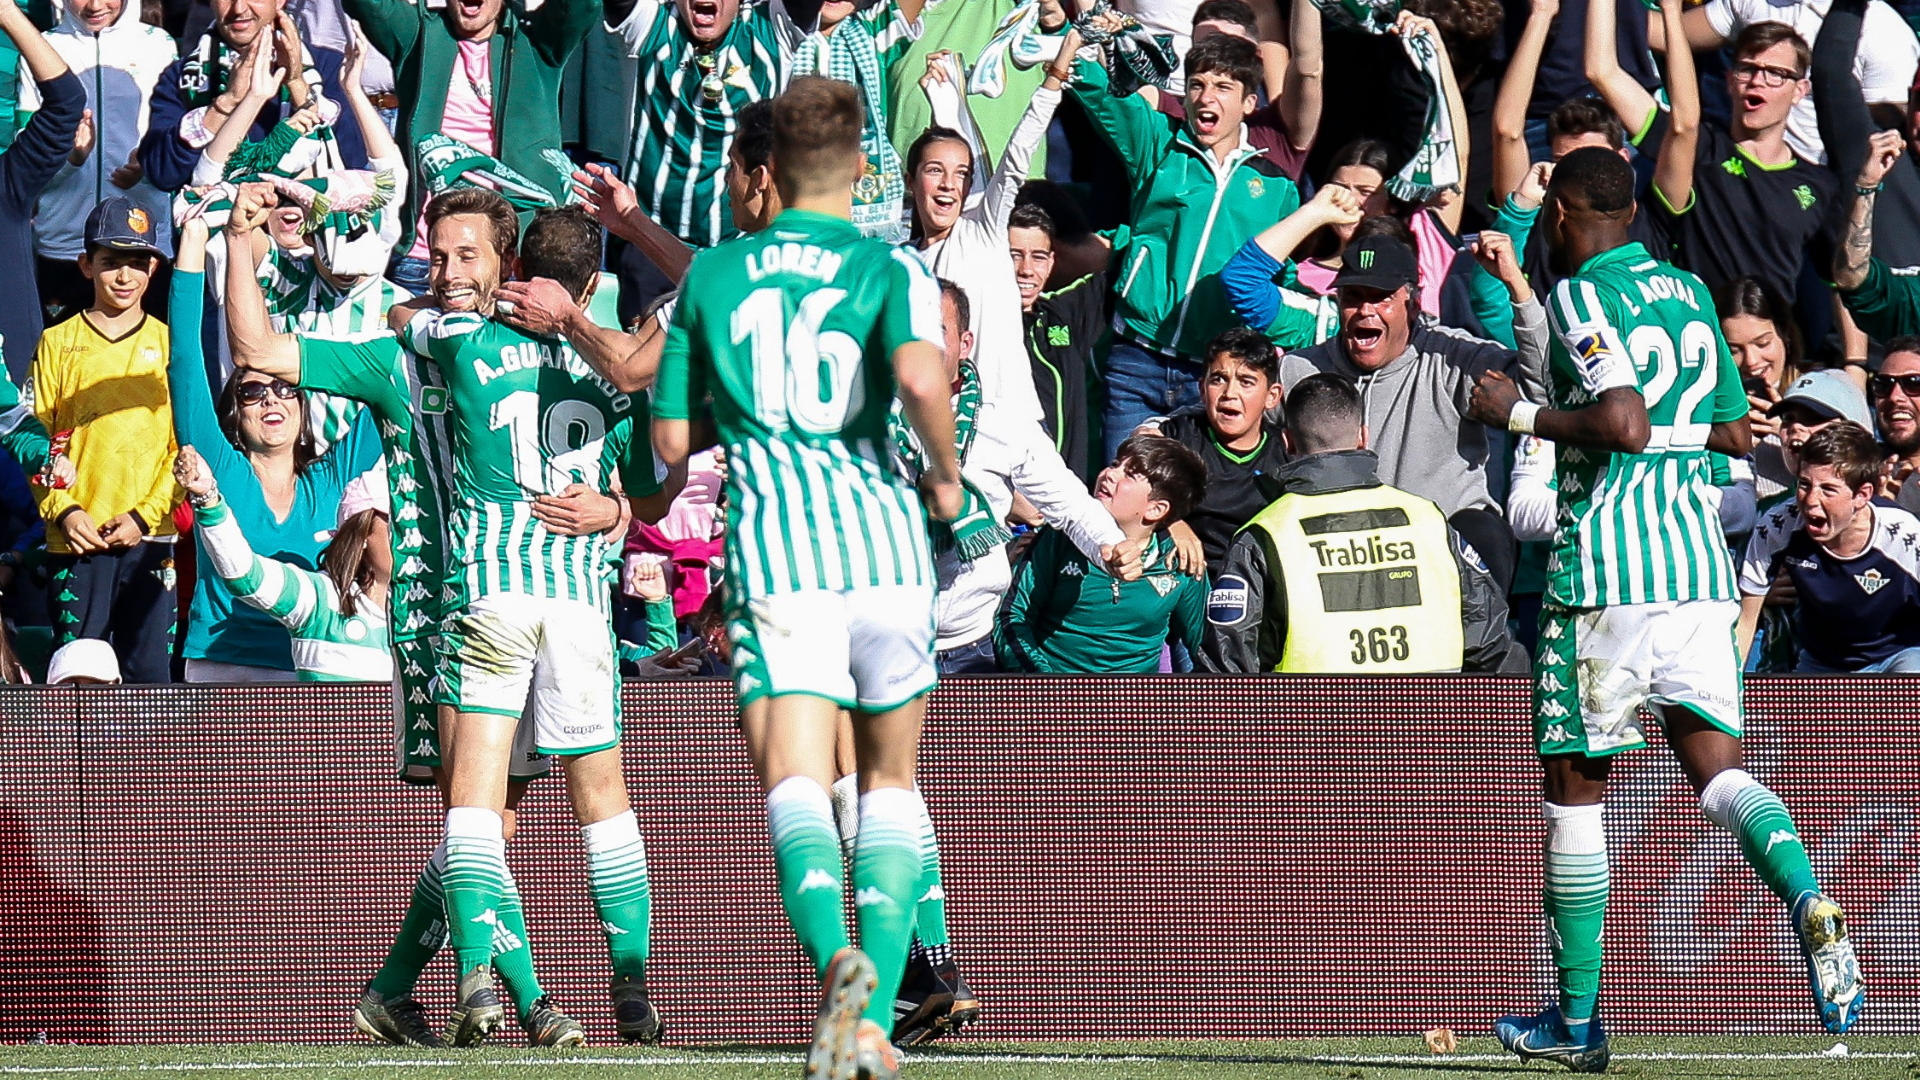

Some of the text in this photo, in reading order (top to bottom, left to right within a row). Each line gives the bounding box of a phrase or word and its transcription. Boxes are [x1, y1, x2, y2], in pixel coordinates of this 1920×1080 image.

[730, 286, 867, 435] 16
[1626, 320, 1718, 454] 22
[1797, 379, 1813, 388] P
[489, 389, 606, 499] 18
[1308, 535, 1416, 567] Trablisa
[1388, 570, 1414, 580] GRUPO
[1349, 625, 1411, 665] 363
